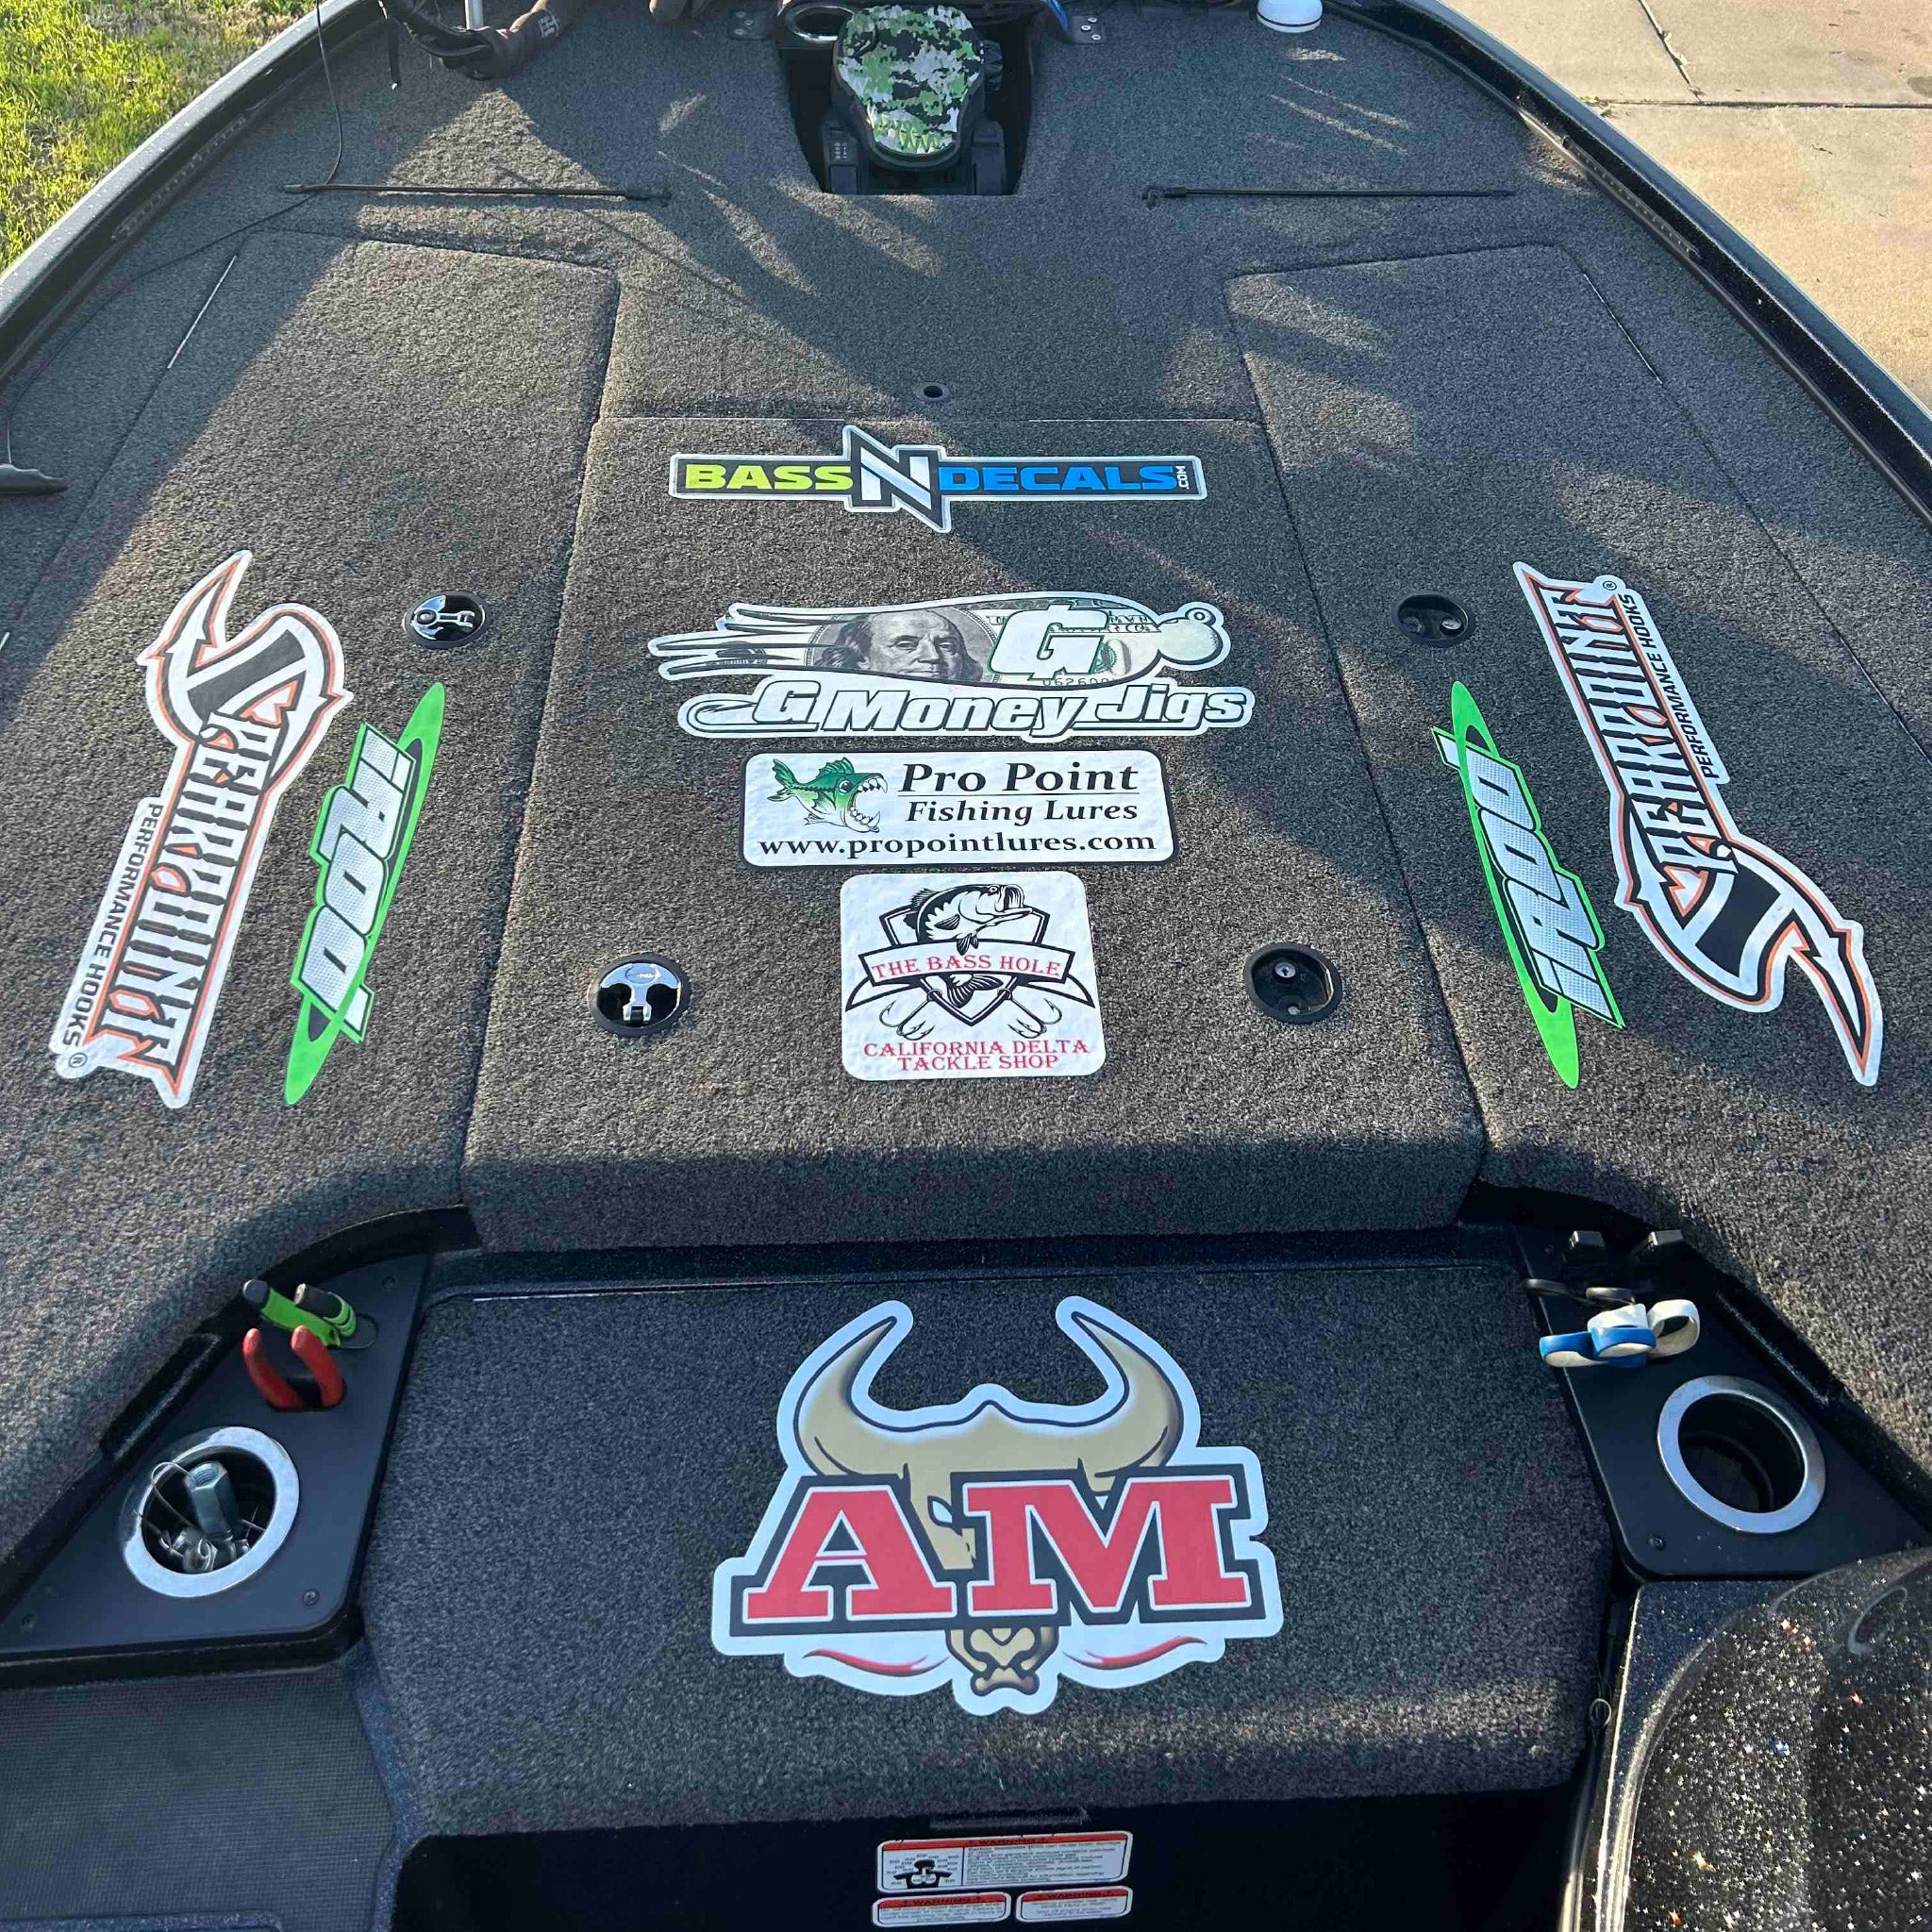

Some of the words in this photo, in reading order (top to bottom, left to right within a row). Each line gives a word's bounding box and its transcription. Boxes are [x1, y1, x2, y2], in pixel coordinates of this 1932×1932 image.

[684, 464, 853, 491] BASS
[938, 466, 1174, 491] DECALS
[1620, 592, 1653, 649] HOOKS
[752, 680, 821, 726] G
[821, 688, 1089, 738] Money
[1095, 683, 1247, 728] Jigs
[1650, 651, 1715, 780] PERFORMANCE
[899, 763, 986, 793] Pro
[1002, 761, 1139, 792] Point
[907, 799, 1032, 826] Fishing
[1044, 799, 1138, 821] Lures
[759, 832, 1157, 859] www.propointlures.com
[94, 804, 163, 958] PERFORMANCE
[872, 960, 919, 981] THE
[926, 953, 991, 972] BASS
[1000, 956, 1062, 977] HOLE
[64, 960, 100, 1049] HOOKS
[864, 1041, 1005, 1058] CALIFORNIA
[1012, 1040, 1090, 1055] DELTA
[897, 1056, 991, 1072] TACKLE
[999, 1054, 1059, 1070] SHOP
[743, 1474, 1253, 1624] AM
